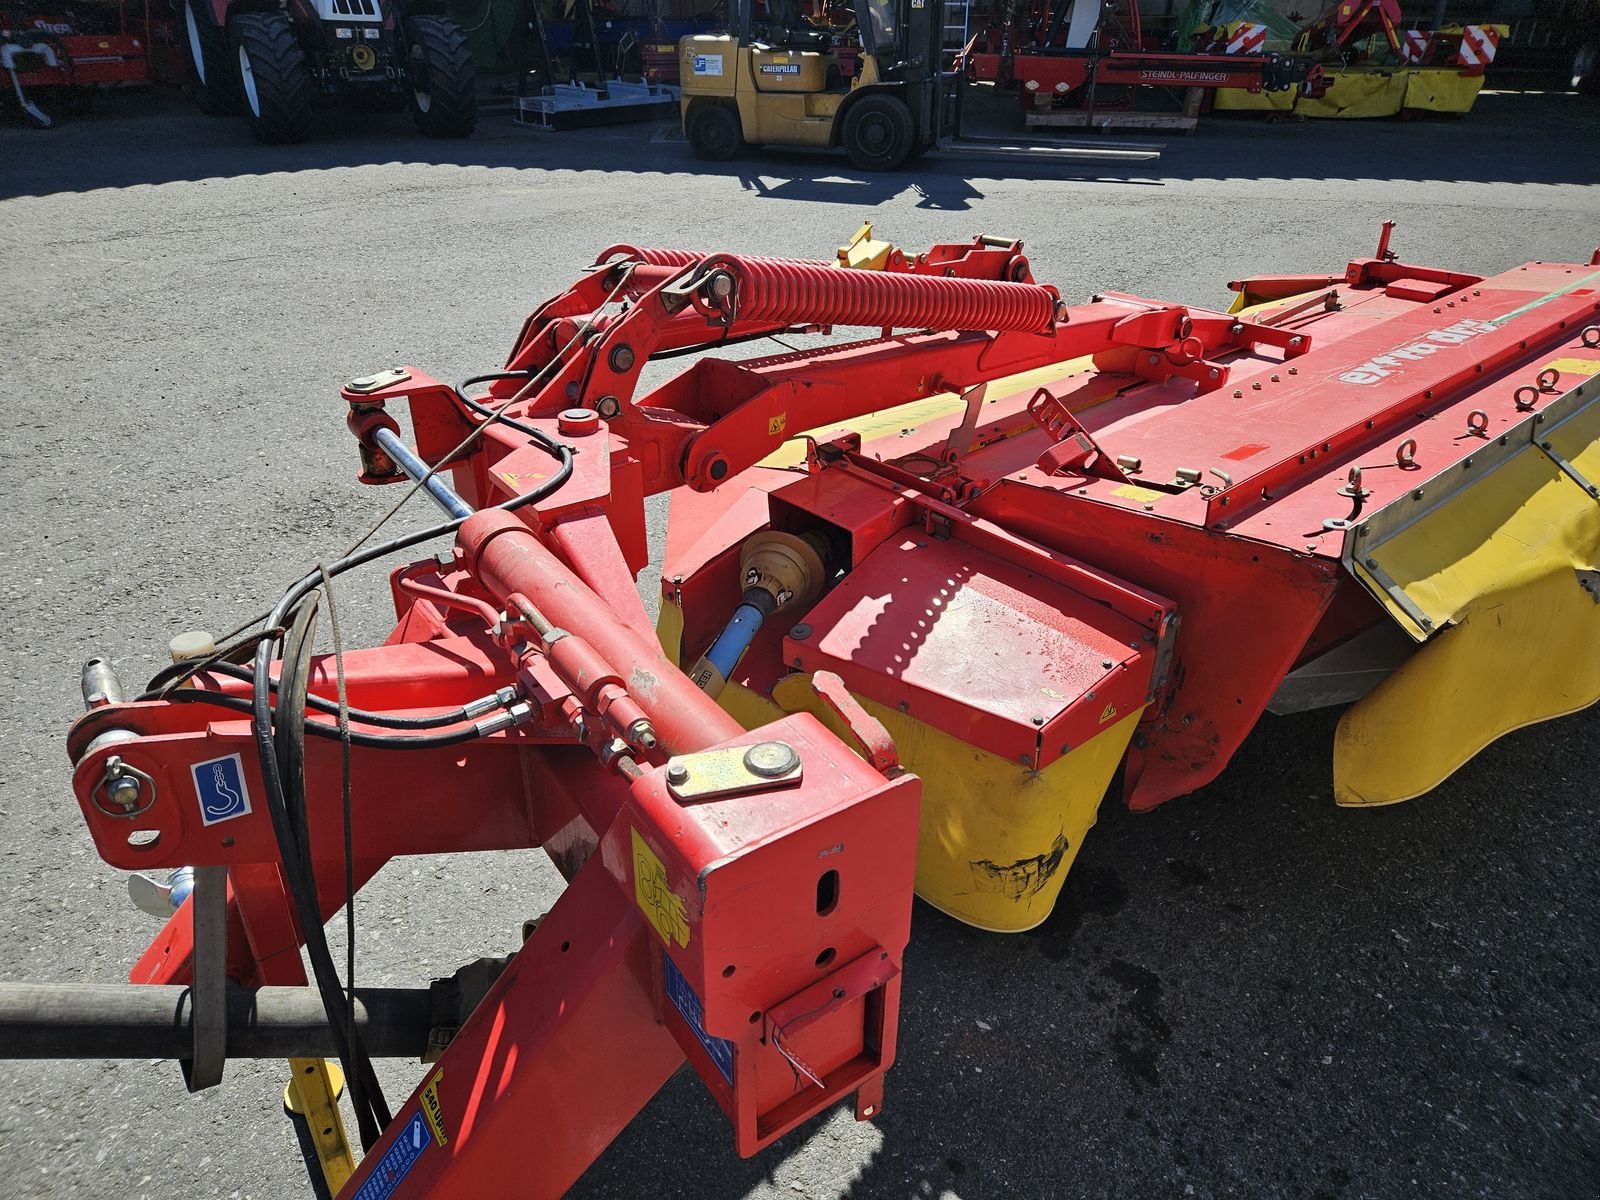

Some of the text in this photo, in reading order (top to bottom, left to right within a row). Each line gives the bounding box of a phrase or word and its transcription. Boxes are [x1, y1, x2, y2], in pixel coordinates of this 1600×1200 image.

[763, 65, 798, 73] CATERPILLAR
[1141, 70, 1227, 81] STEINDL-PALFINGER
[425, 1088, 437, 1111] 540
